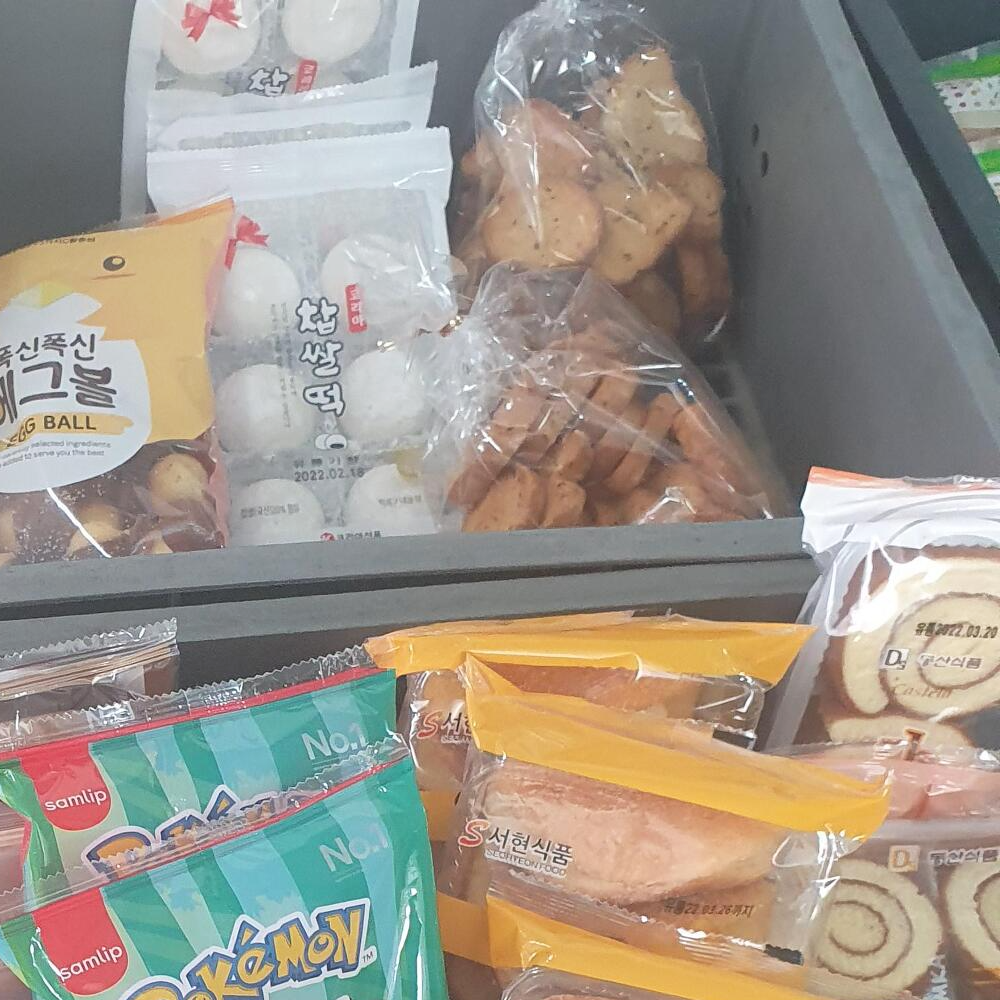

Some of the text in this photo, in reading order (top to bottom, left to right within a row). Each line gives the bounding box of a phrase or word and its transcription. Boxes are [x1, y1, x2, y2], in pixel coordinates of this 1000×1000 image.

[295, 297, 346, 417] 찹쌀떡
[43, 415, 97, 430] BALL
[301, 721, 367, 760] No.1
[44, 788, 107, 811] samlip
[319, 831, 389, 872] No.1
[489, 827, 574, 867] 서현식품
[60, 943, 123, 983] samlip
